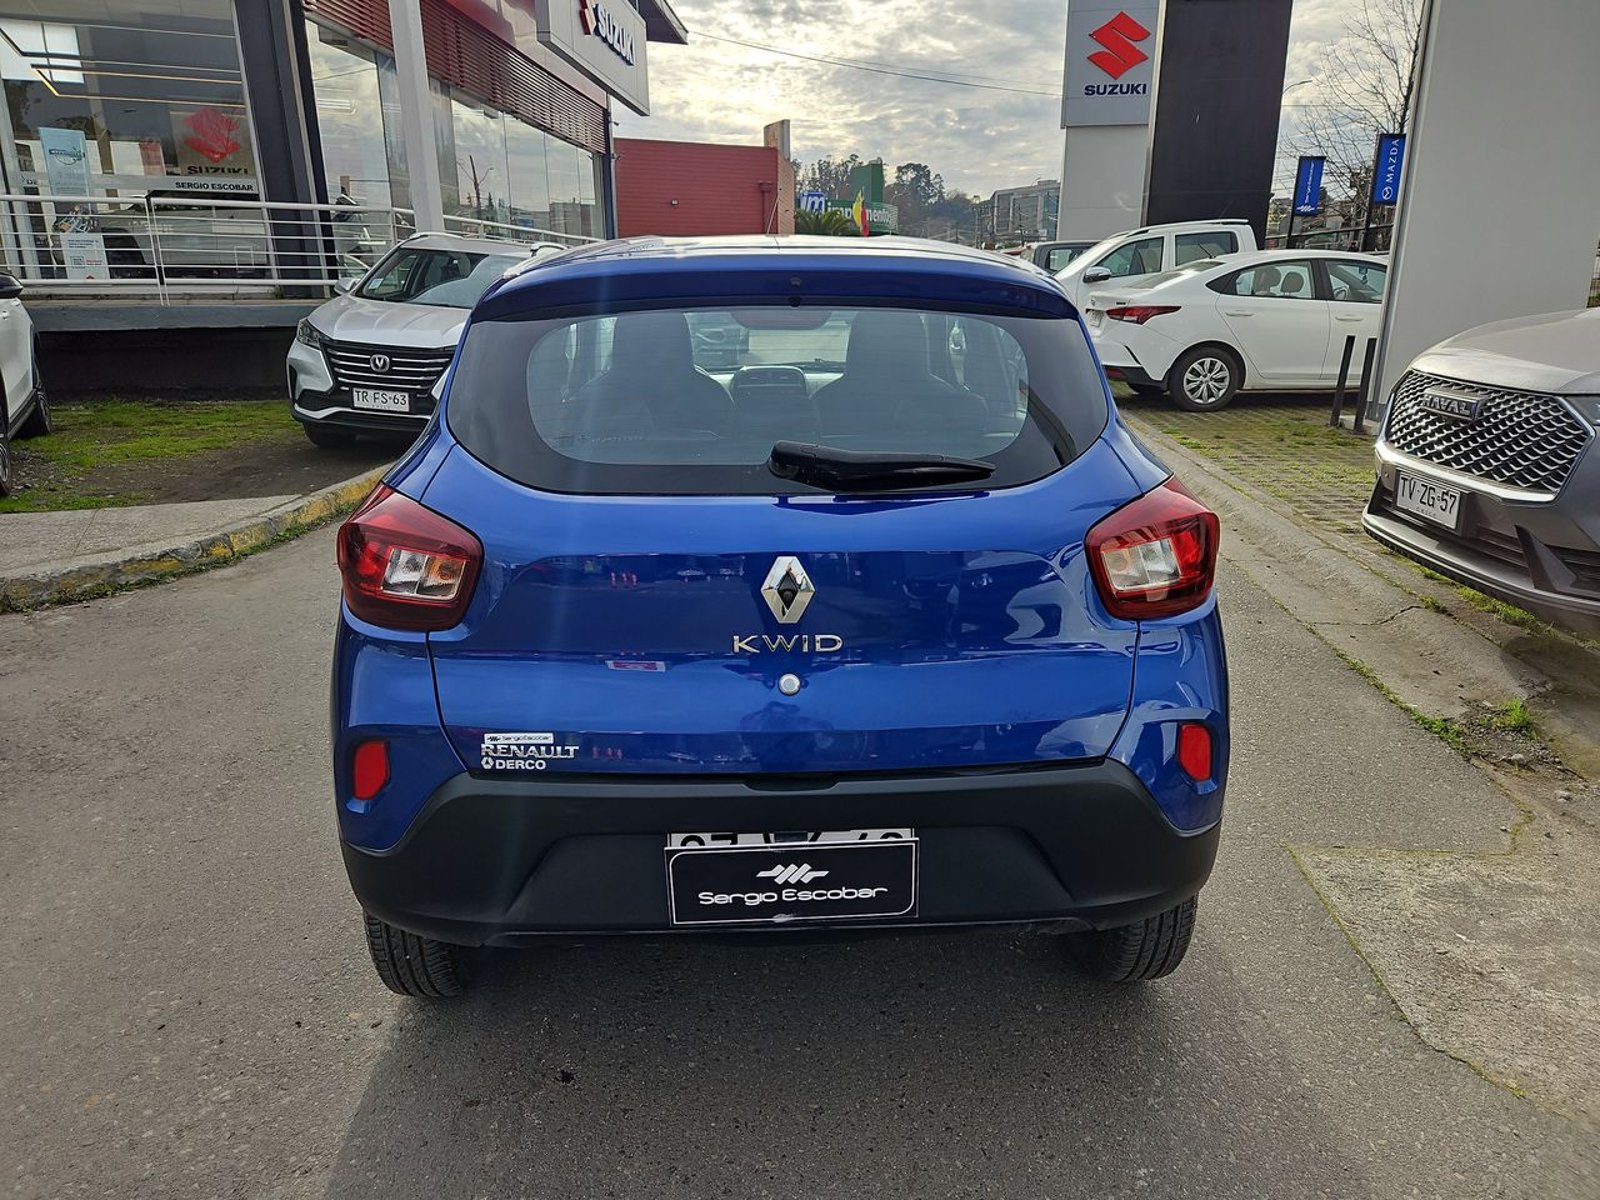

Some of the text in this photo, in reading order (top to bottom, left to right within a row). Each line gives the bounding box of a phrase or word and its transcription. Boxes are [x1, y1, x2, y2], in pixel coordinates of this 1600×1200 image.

[597, 3, 636, 66] SUZUKI
[1084, 83, 1147, 96] SUZUKI
[1386, 138, 1401, 183] MAZDA
[187, 165, 249, 175] SUZUKI
[175, 182, 254, 192] SERGIO ESCOBAR
[1424, 394, 1471, 415] HAVAL
[733, 634, 843, 653] KWID
[481, 743, 579, 758] RENAULT
[495, 759, 546, 770] DERCO
[698, 886, 888, 906] Sergio Escobar
